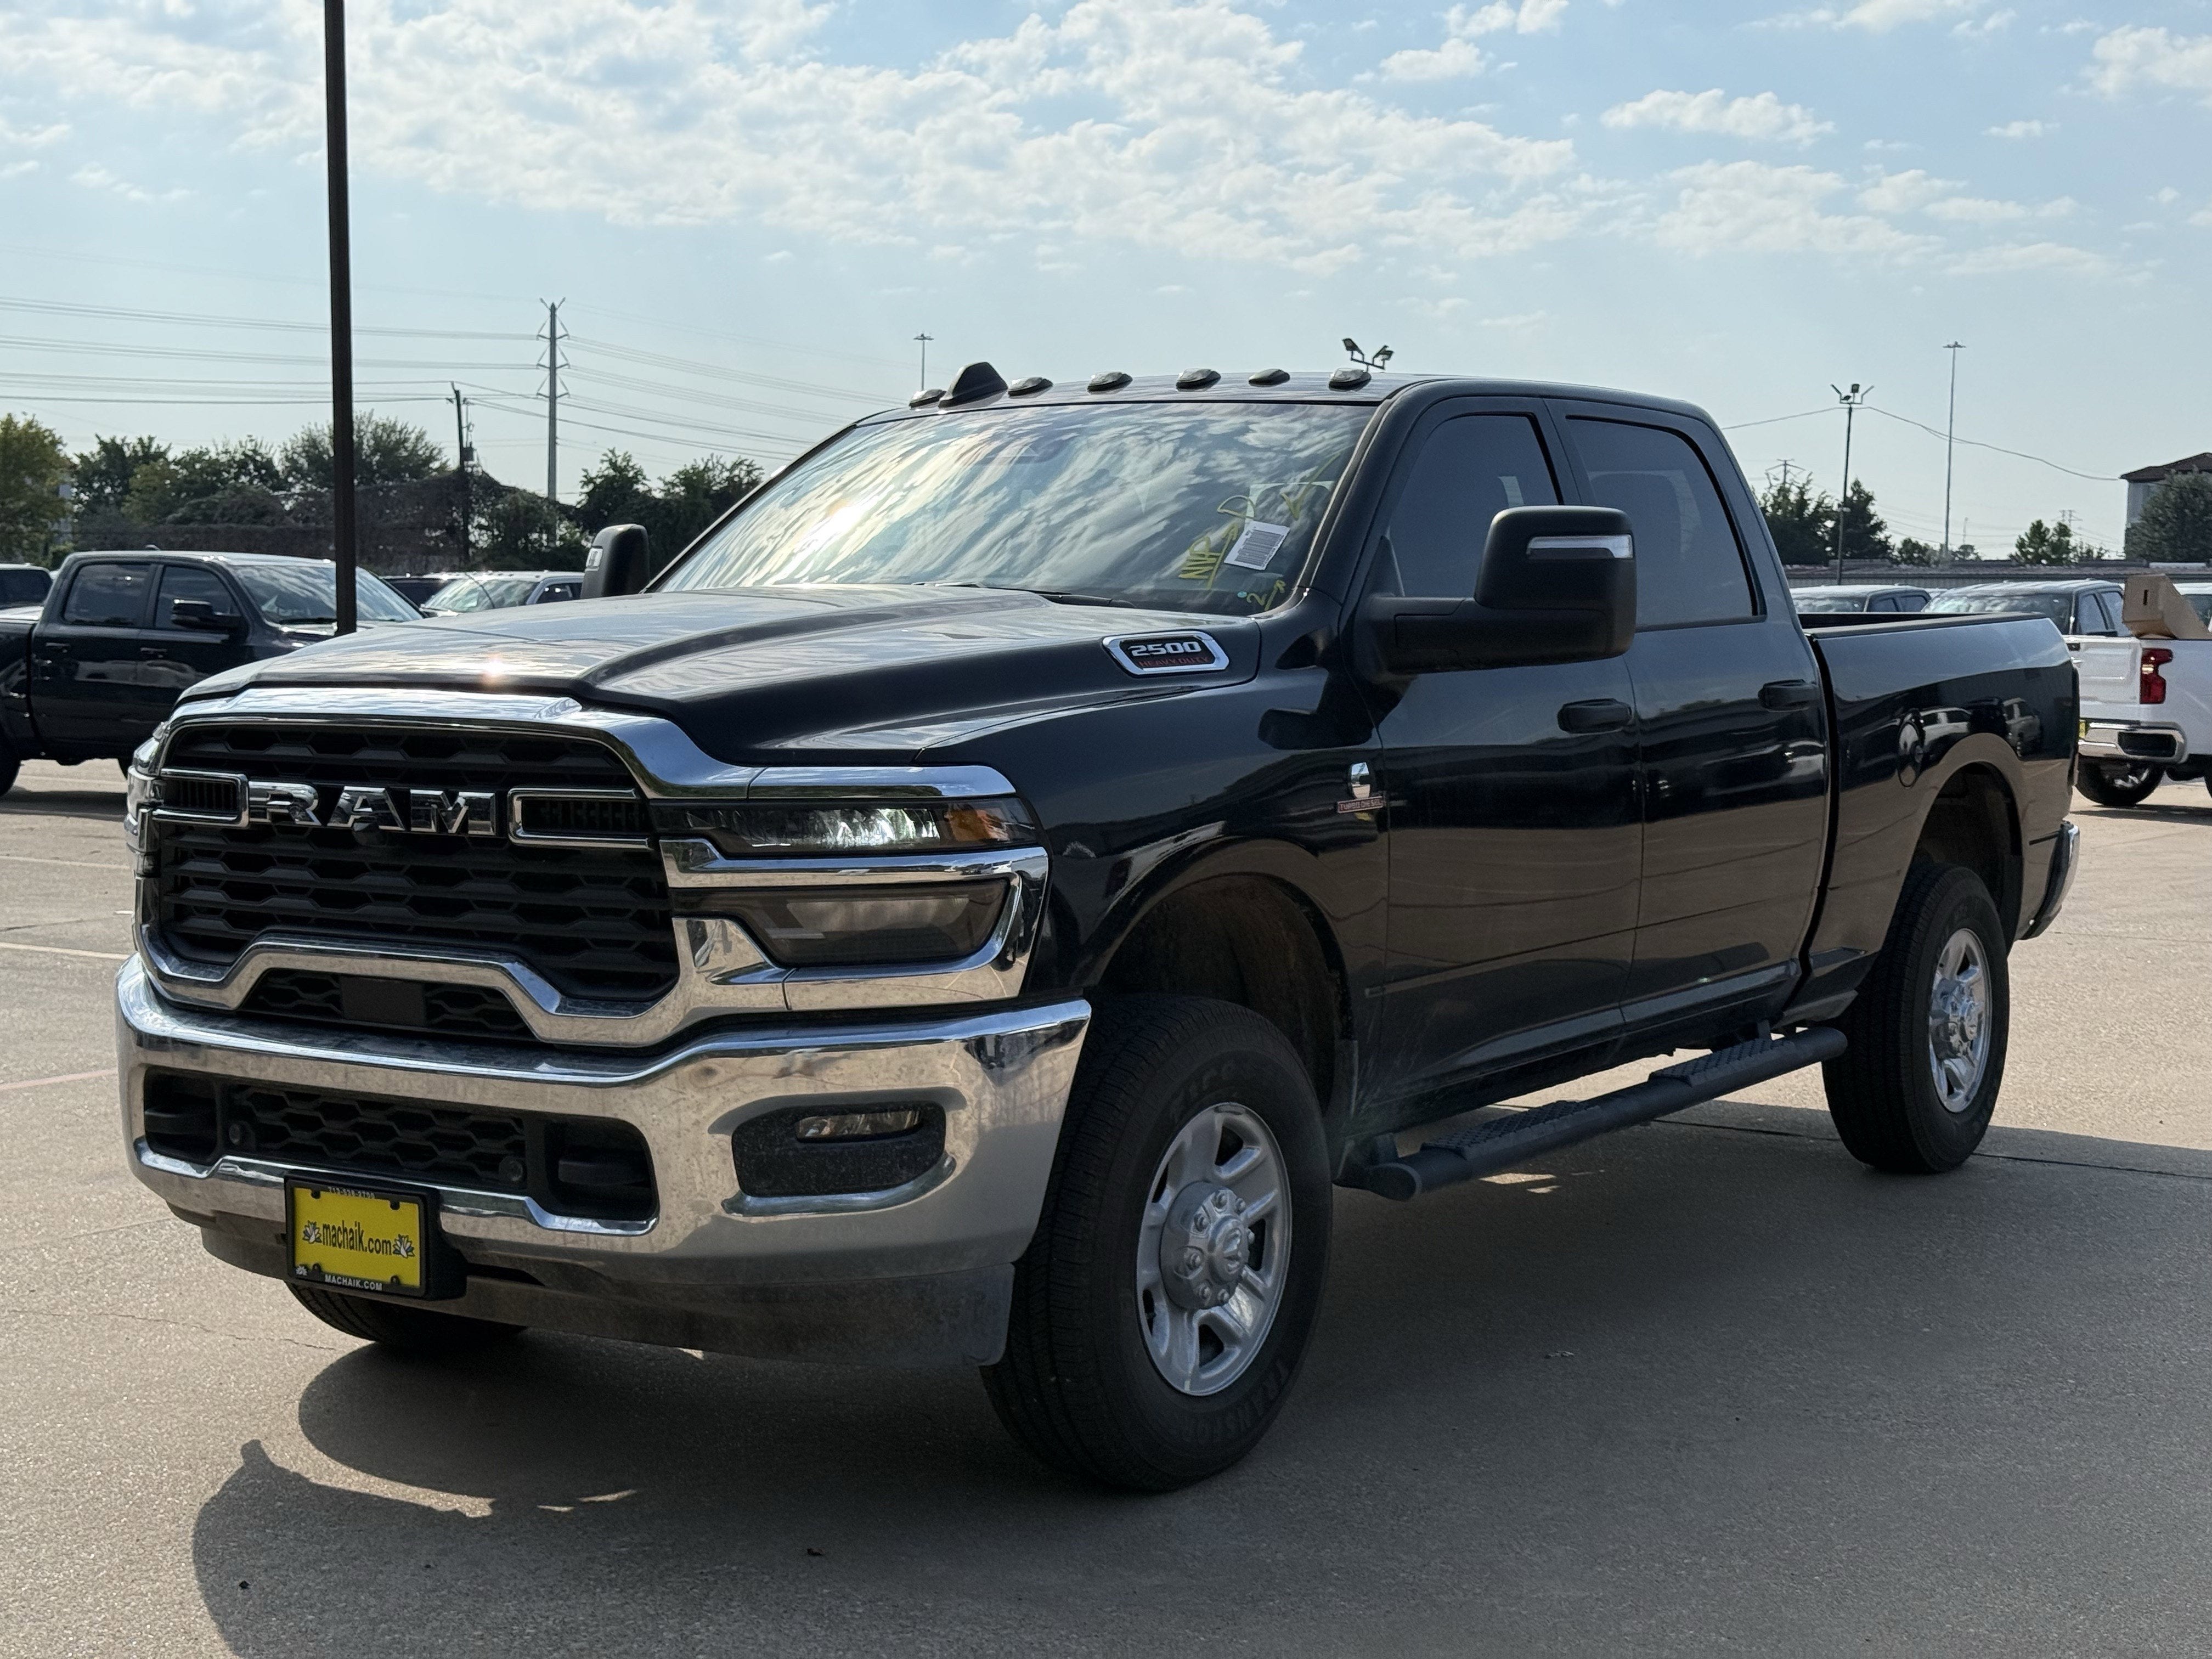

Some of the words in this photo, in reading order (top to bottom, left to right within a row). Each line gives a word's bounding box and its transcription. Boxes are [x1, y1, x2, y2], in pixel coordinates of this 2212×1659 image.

[1128, 641, 1202, 657] 2500
[1138, 658, 1177, 667] HEAVY
[1178, 656, 1210, 664] DUTY
[248, 780, 496, 837] RAM
[322, 1220, 392, 1256] machaik.com
[325, 1274, 382, 1291] MACHAIK.COM
